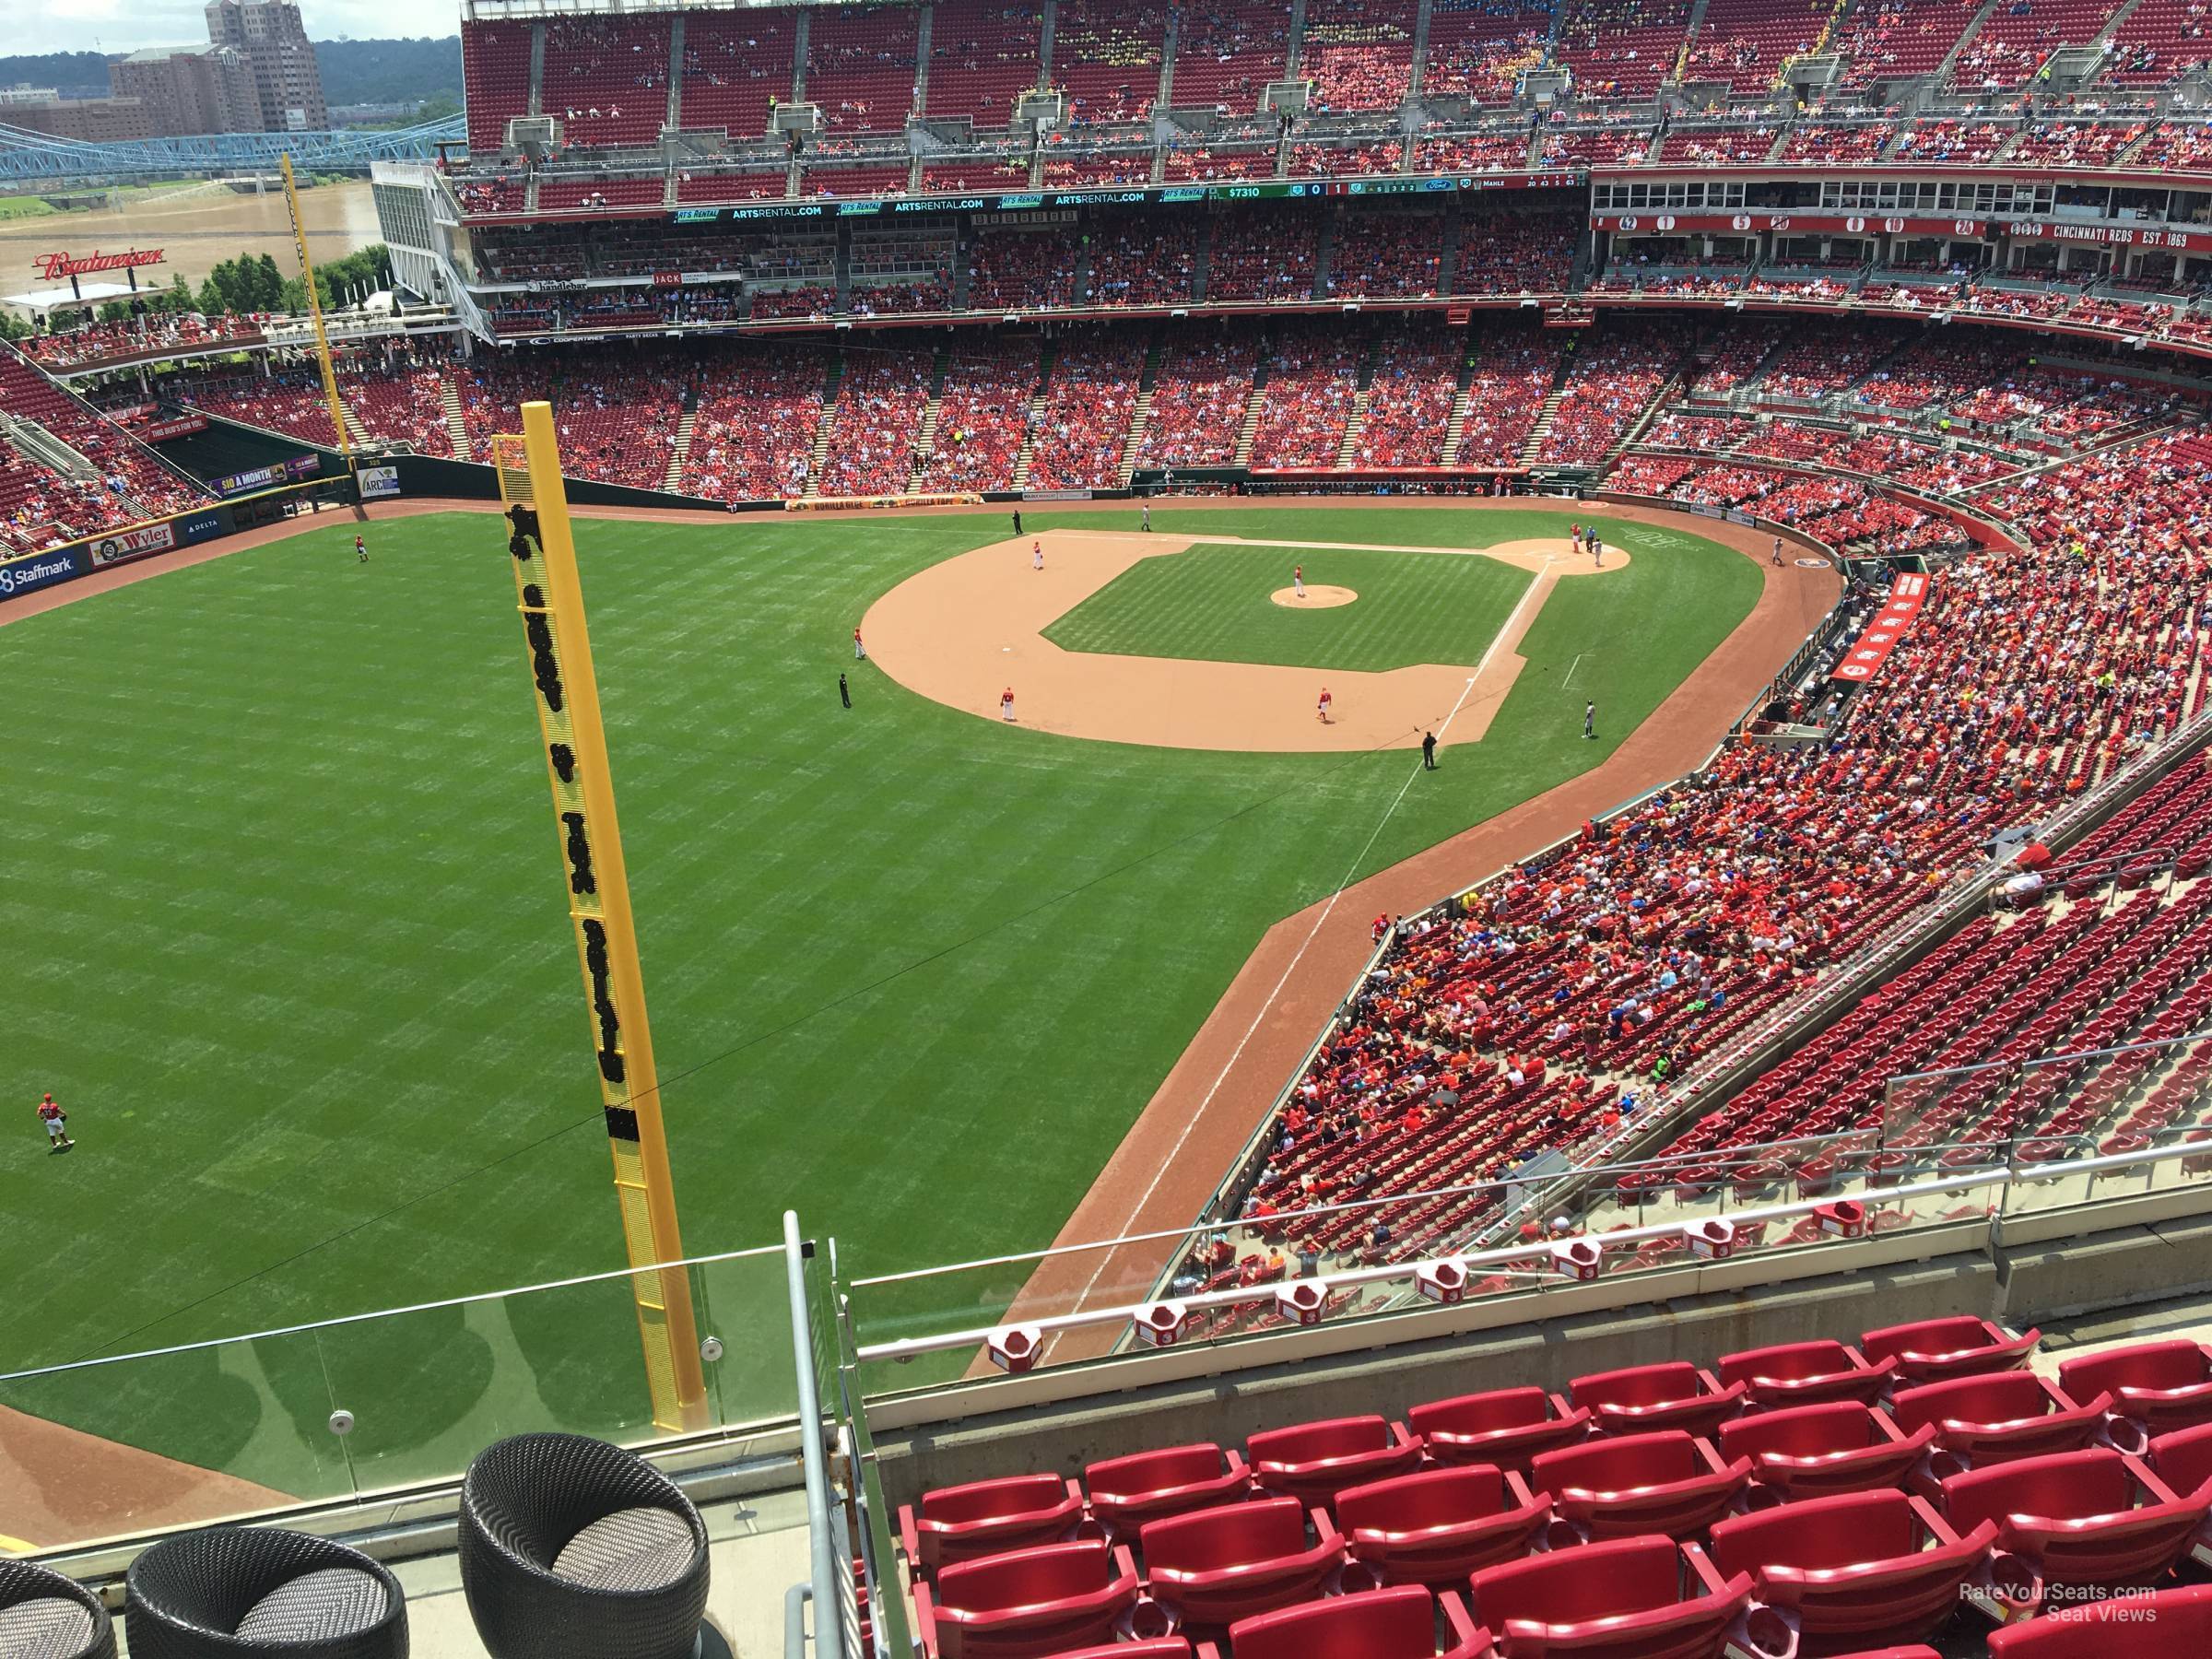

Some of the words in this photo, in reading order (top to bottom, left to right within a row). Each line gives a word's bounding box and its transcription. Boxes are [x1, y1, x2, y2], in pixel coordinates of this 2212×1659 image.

[1229, 187, 1260, 197] $7310
[1312, 184, 1321, 194] 0
[1335, 183, 1341, 194] 1
[1056, 193, 1144, 205] ARTSRENTAL.COM
[895, 199, 983, 212] ARTSRENTAL.COM
[733, 206, 822, 219] ARTSRENTAL.COM
[1621, 217, 1634, 229] 42
[1738, 217, 1746, 229] 5
[1959, 220, 1971, 234] 24
[2053, 225, 2106, 241] CINCINNATI
[2108, 229, 2133, 242] REDS
[2142, 231, 2164, 244] EST.
[2167, 233, 2187, 248] 1869
[33, 247, 164, 280] Budweiser
[655, 273, 681, 284] JACK
[539, 281, 587, 291] handlebar
[1690, 409, 1715, 418] SCOUTS
[151, 429, 165, 438] THIS
[165, 425, 182, 435] BUD'S
[181, 423, 192, 431] FOR
[221, 478, 235, 490] $10
[236, 476, 242, 487] A
[242, 468, 272, 485] MONTH
[366, 480, 383, 492] ARC
[815, 501, 845, 511] GORILLA
[845, 500, 864, 510] GLUE
[906, 498, 935, 506] GORILLA
[936, 497, 953, 505] TAPE
[194, 519, 218, 531] DELTA
[122, 528, 169, 550] Wyler
[15, 557, 73, 585] Staffmark
